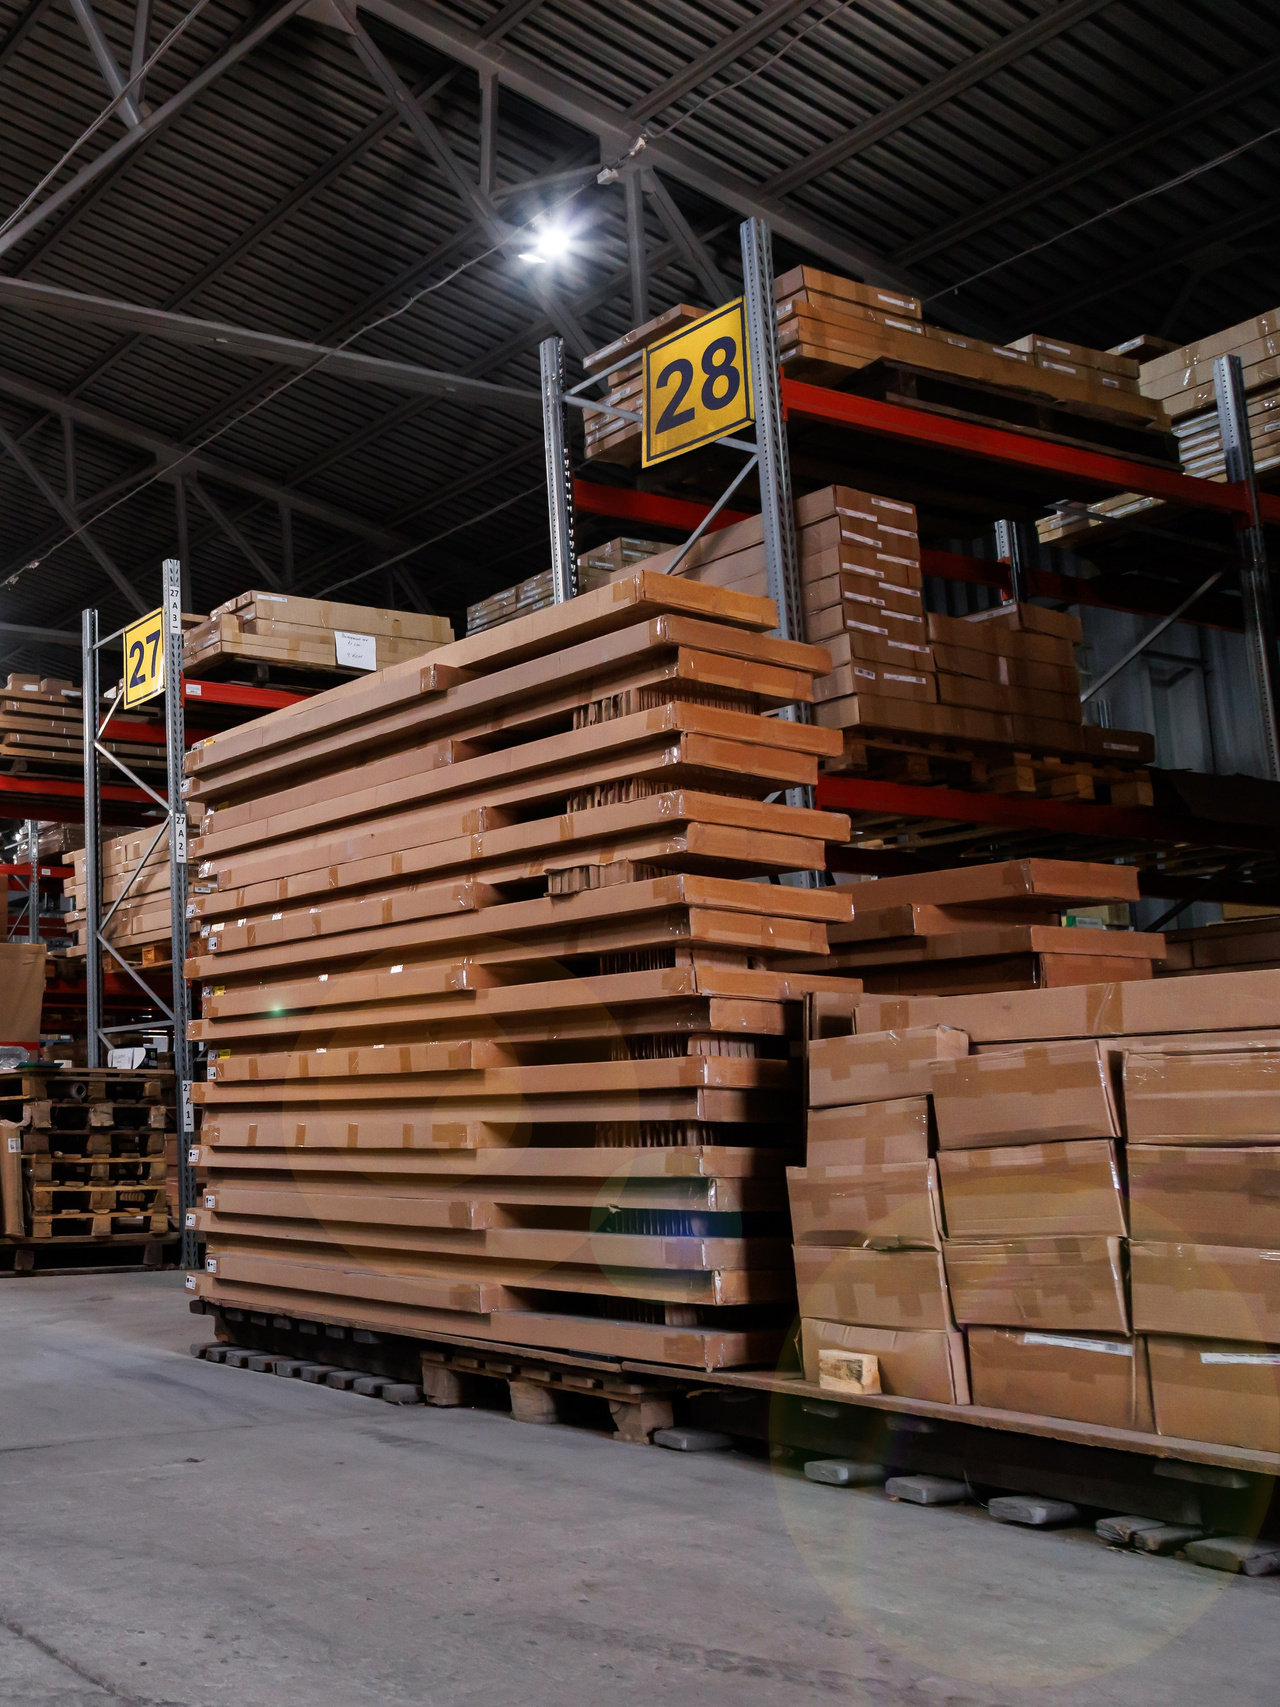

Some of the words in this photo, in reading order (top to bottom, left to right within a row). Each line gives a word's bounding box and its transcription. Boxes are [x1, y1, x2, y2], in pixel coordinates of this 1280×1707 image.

[655, 336, 740, 435] 28
[170, 589, 179, 597] 27
[173, 614, 177, 622] 3
[129, 629, 161, 689] 27
[176, 816, 185, 825] 27
[178, 829, 184, 837] A
[179, 842, 183, 850] 2
[186, 1110, 191, 1119] 1
